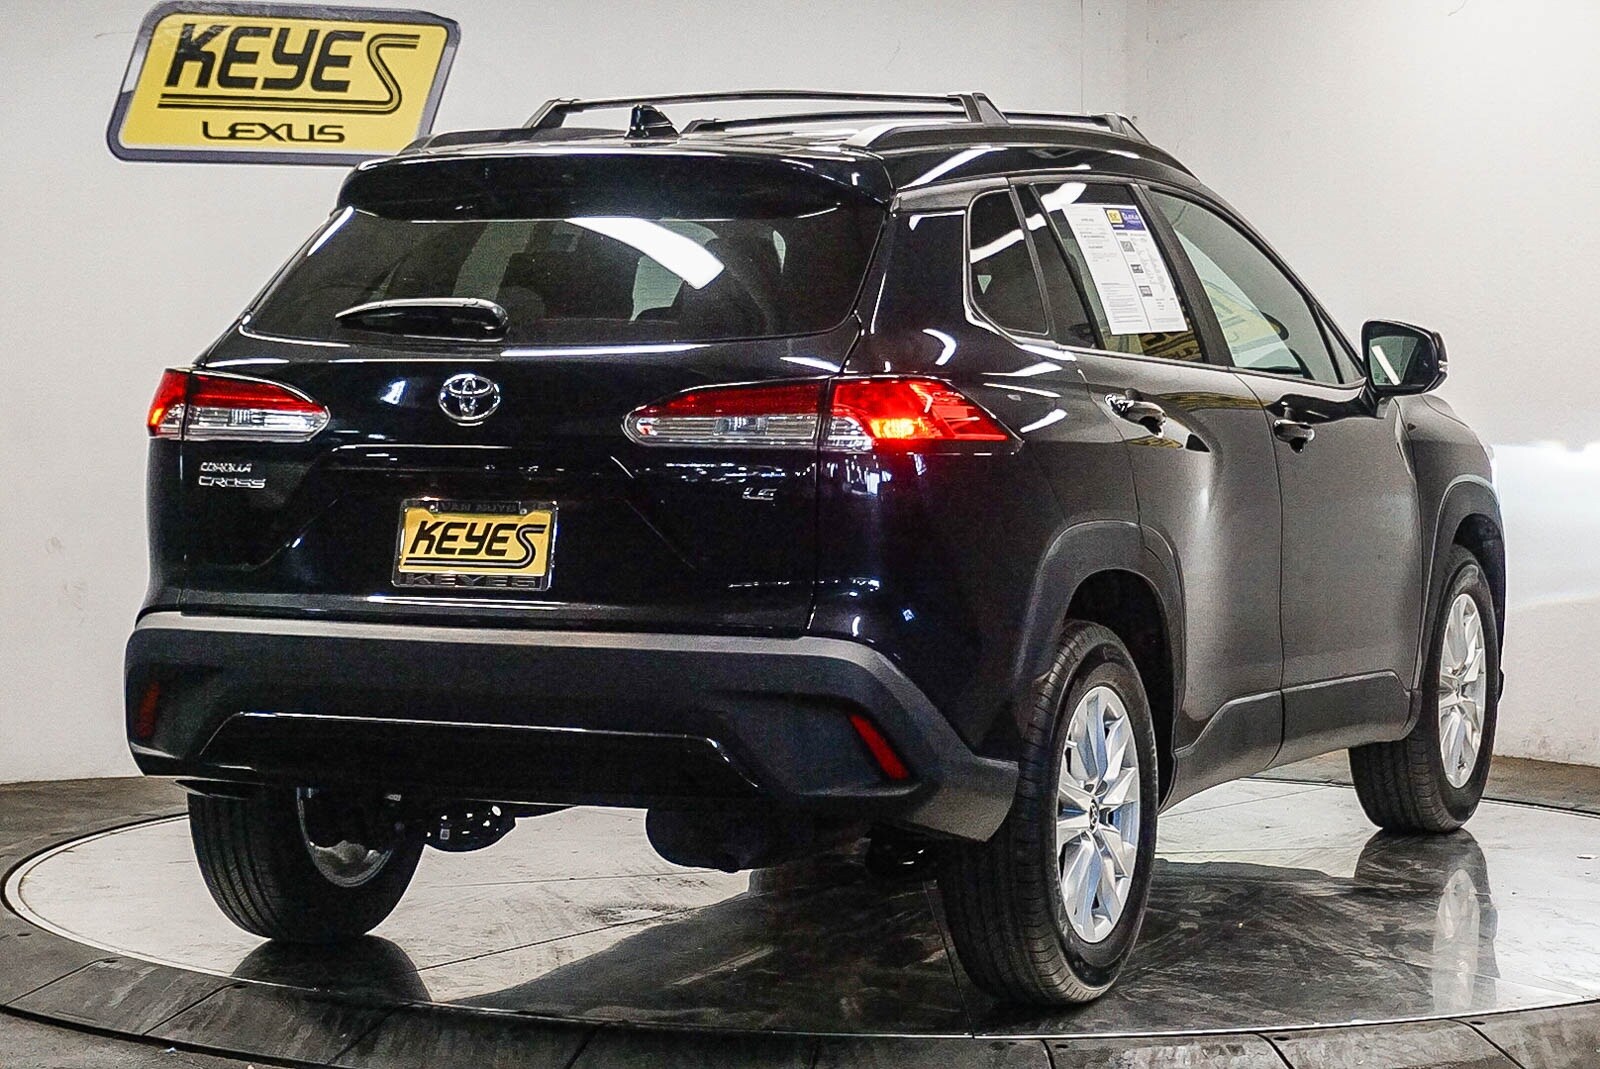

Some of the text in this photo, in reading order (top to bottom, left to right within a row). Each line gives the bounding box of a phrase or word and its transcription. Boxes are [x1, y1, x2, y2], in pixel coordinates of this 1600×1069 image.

[156, 23, 420, 115] KEYES
[202, 121, 345, 143] LEXUS
[198, 475, 267, 489] CROSS
[742, 487, 778, 501] LE
[404, 520, 547, 569] KEYES
[405, 573, 536, 587] KEYES
